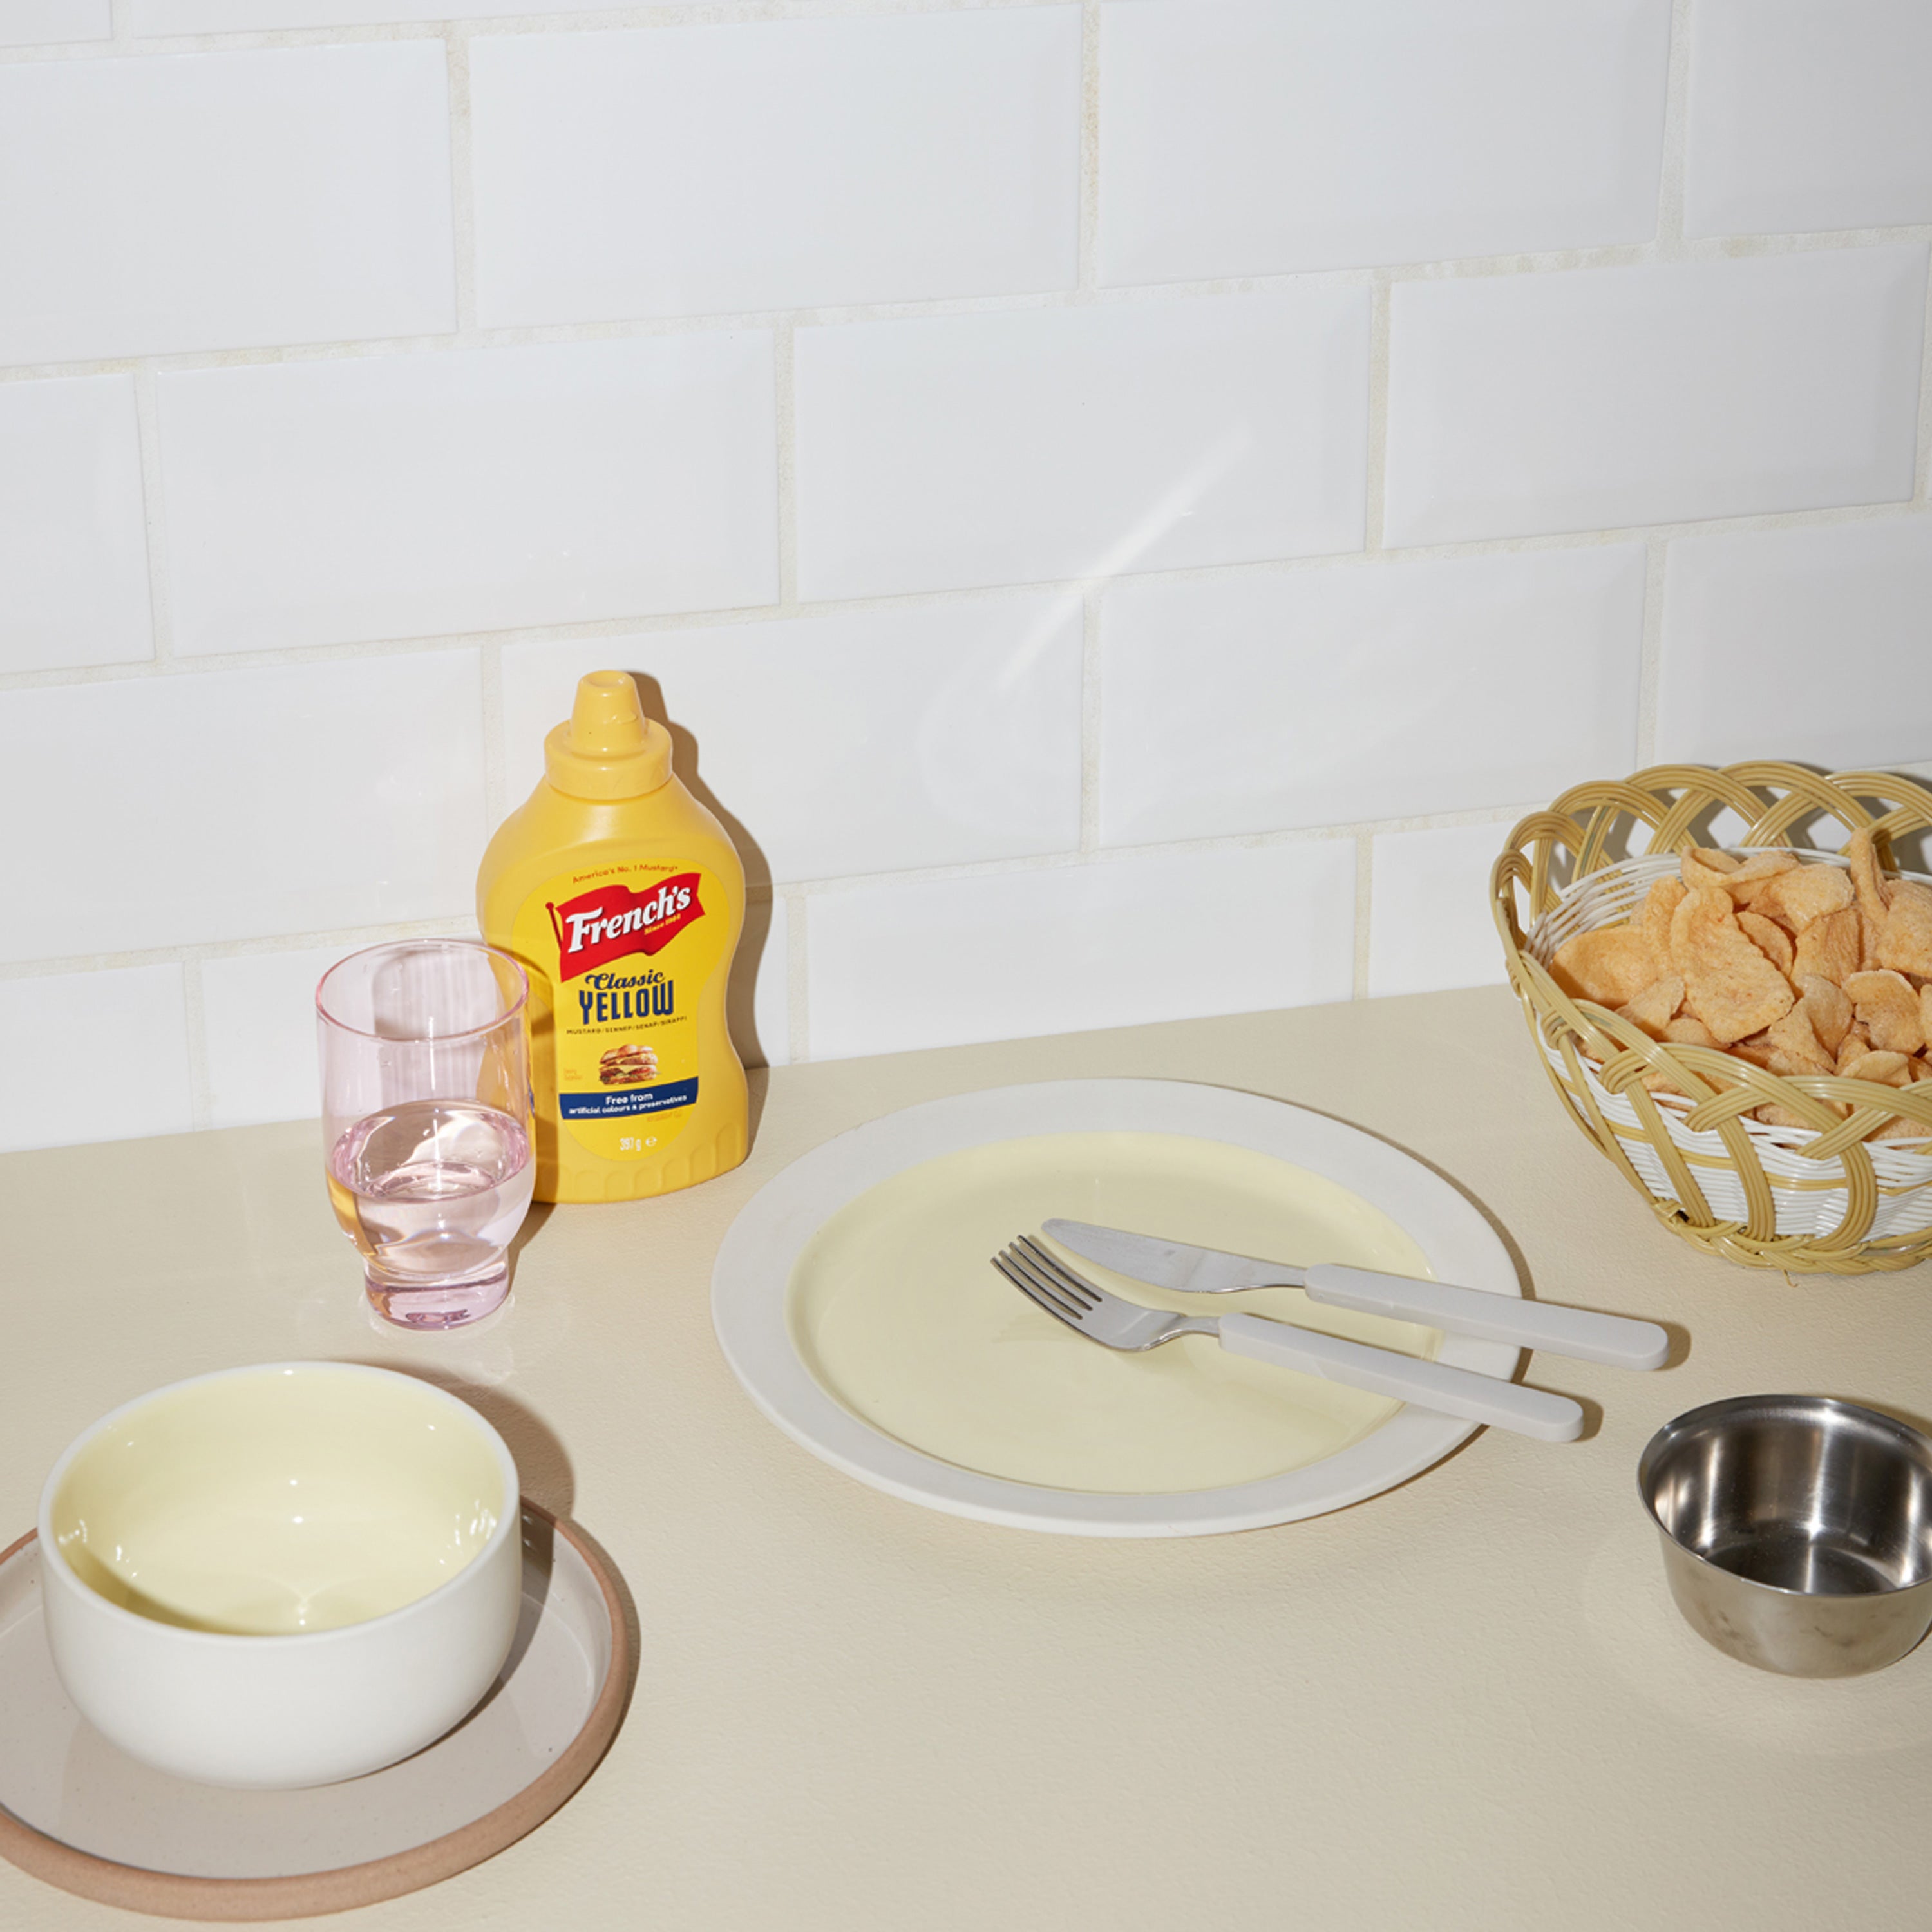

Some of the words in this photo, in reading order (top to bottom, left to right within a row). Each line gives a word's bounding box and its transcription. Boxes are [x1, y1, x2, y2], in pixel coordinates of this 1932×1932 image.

[565, 886, 691, 953] French's
[585, 969, 665, 990] Classic
[578, 980, 674, 1025] YELLOW
[569, 1106, 601, 1115] artificial
[602, 1105, 630, 1113] colours
[639, 1095, 687, 1110] preservatives
[605, 1096, 629, 1105] Free
[630, 1093, 654, 1103] from
